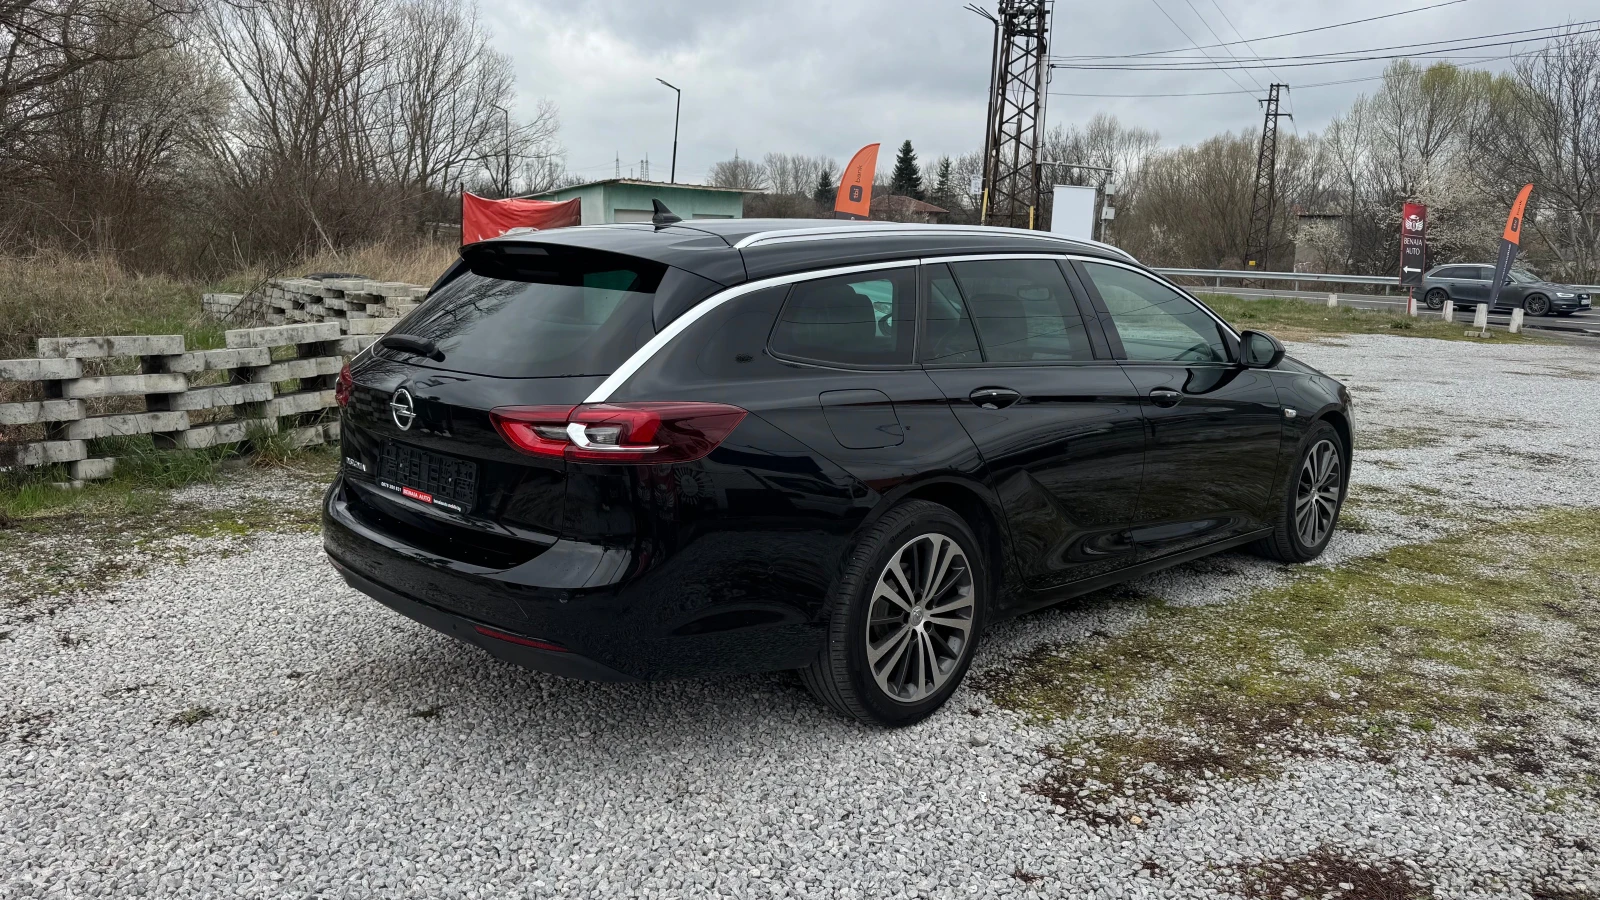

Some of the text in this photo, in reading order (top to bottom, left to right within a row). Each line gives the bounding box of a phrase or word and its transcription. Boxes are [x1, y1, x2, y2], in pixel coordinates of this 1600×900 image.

[855, 165, 863, 183] bank
[1403, 238, 1423, 246] BENAIA
[419, 494, 431, 502] AUTO
